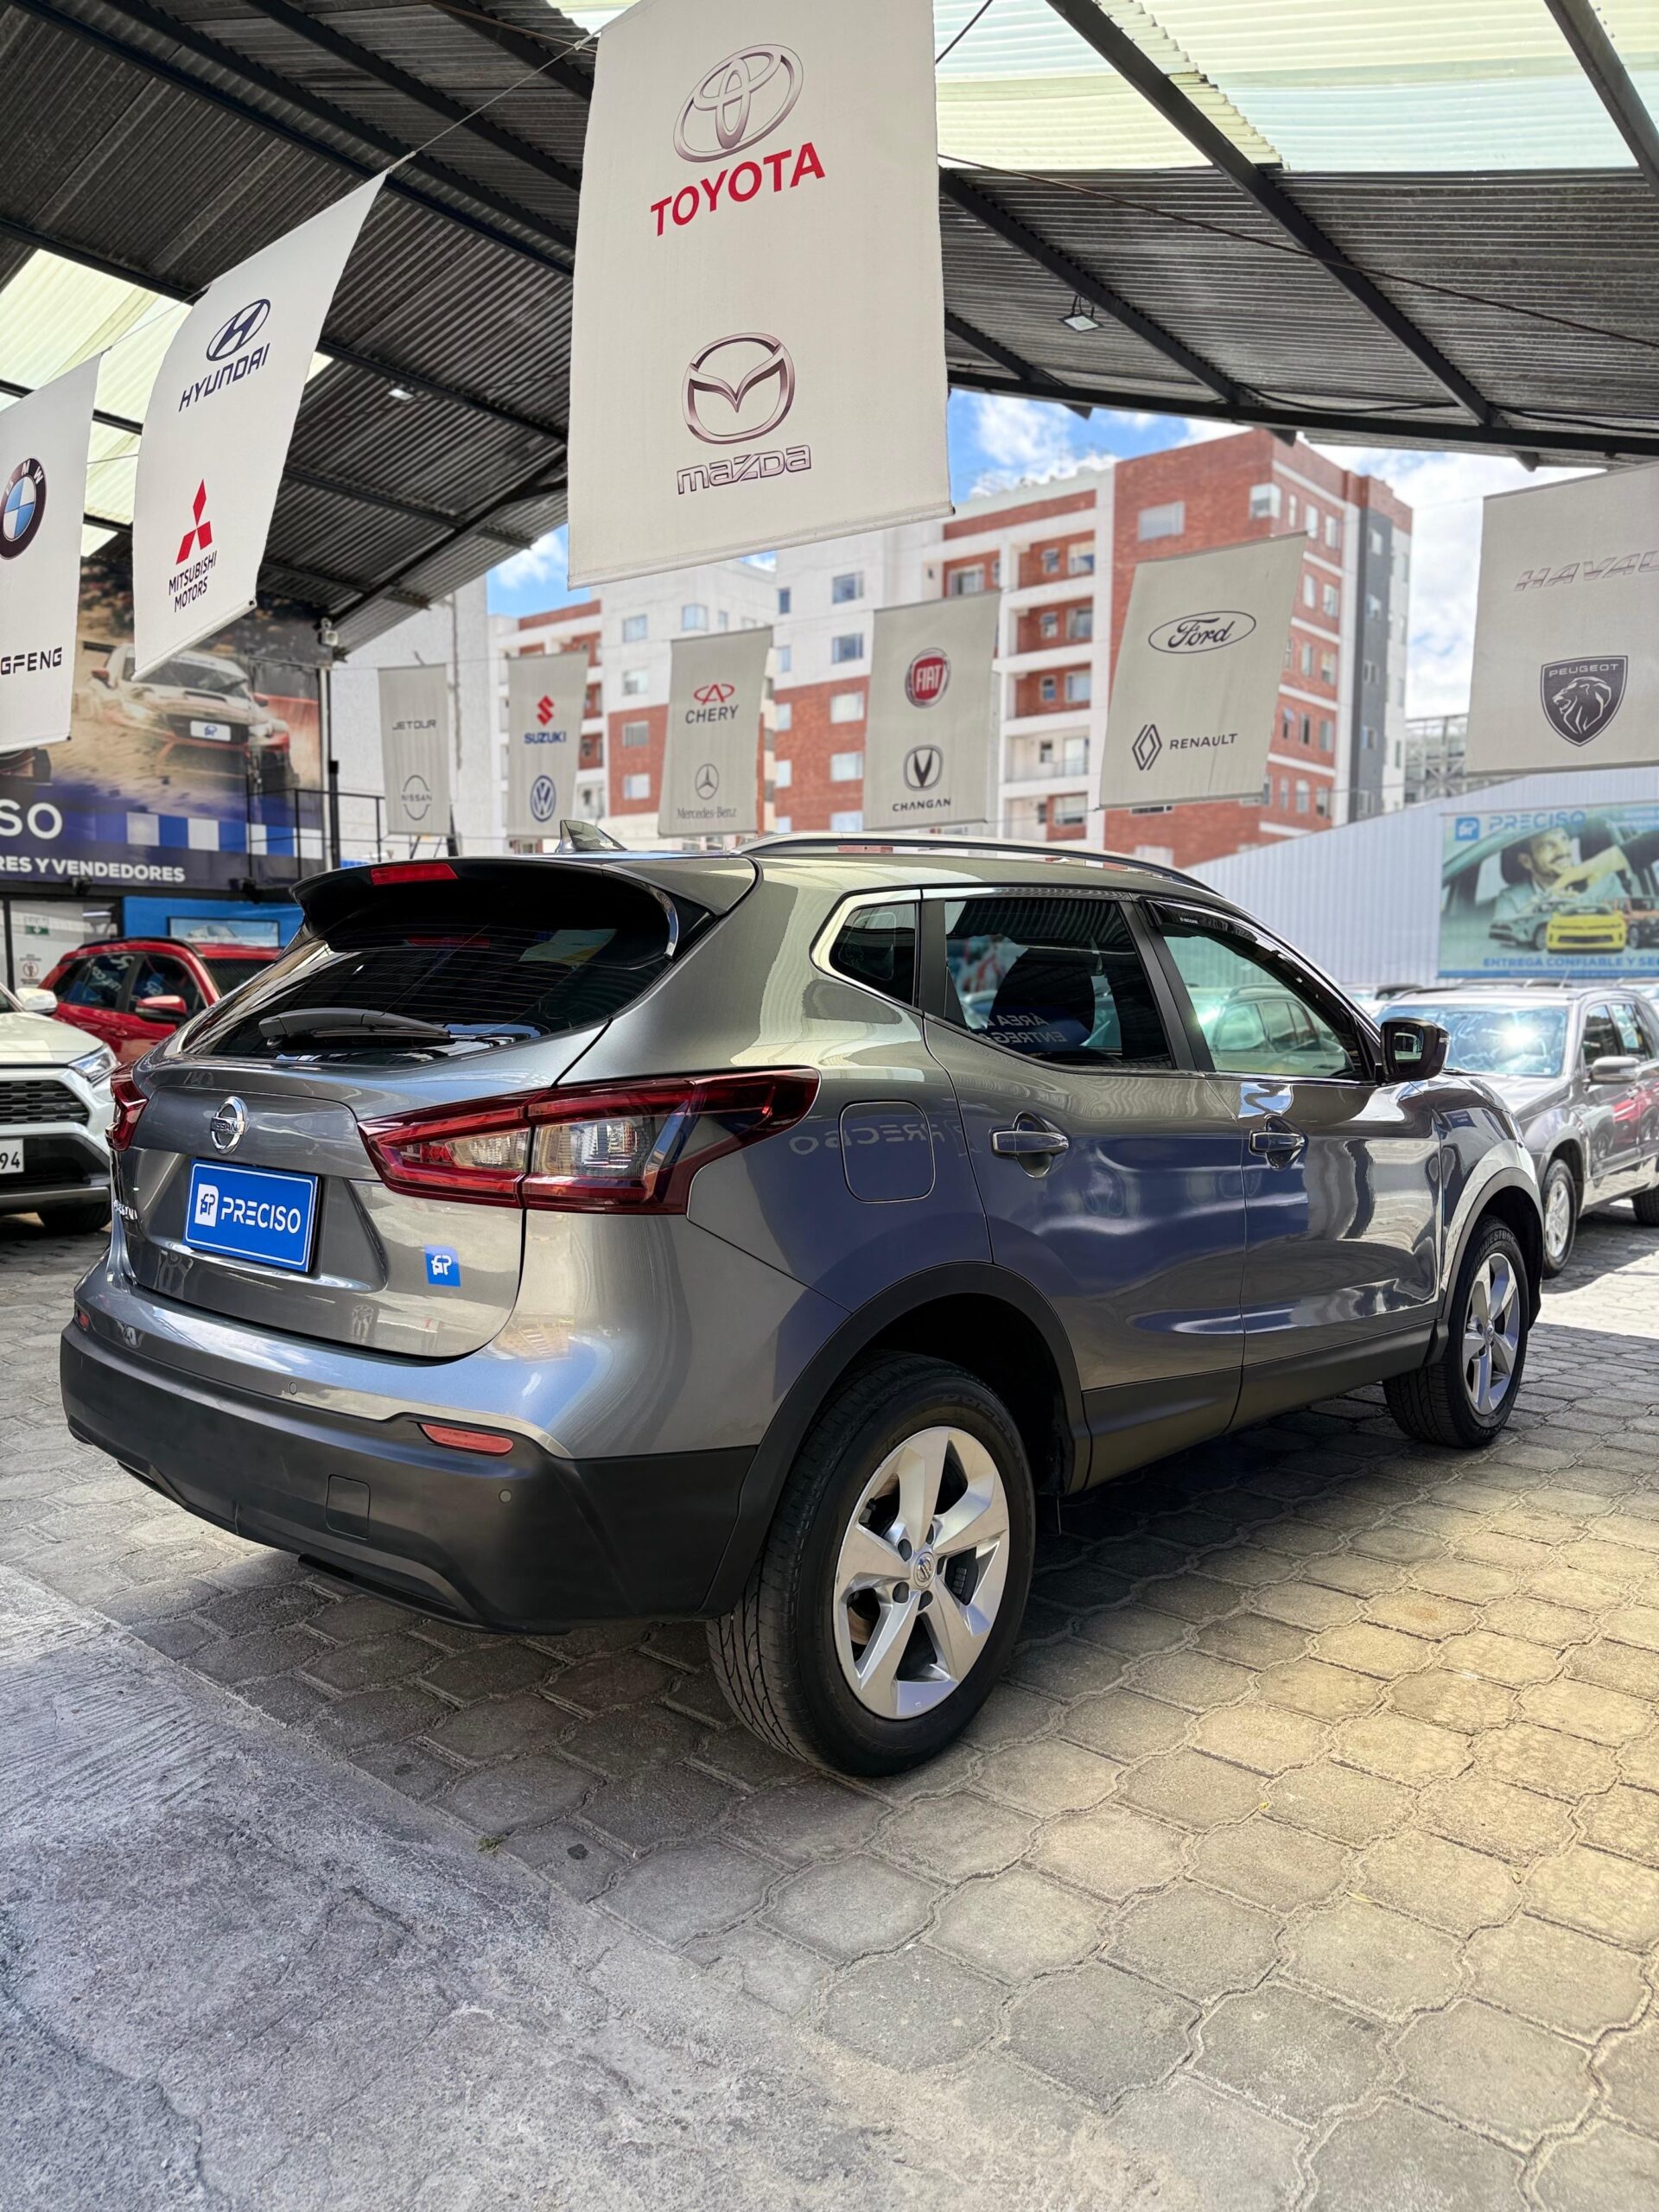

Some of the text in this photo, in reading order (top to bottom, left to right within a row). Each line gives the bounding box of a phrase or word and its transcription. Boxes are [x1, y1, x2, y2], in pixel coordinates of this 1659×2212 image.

[650, 142, 826, 237] TOYOTA
[178, 343, 270, 412] HYUNDAI
[168, 550, 218, 596] MITSUBISHI
[174, 575, 208, 613] MOTORS
[1167, 617, 1233, 648] Ford
[1, 646, 62, 676] GFENG
[1548, 663, 1619, 678] PEUGEOT
[915, 664, 943, 691] FIAT
[392, 719, 436, 731] JETOUR
[685, 704, 739, 725] CHERY
[524, 731, 566, 745] SUZUKI
[1169, 733, 1238, 751] RENAULT
[401, 793, 432, 802] NISSAN
[892, 798, 951, 812] CHANGAN
[0, 798, 63, 840] SO
[677, 806, 737, 820] Mercedes-Benz
[1488, 810, 1586, 830] PRECISO
[35, 857, 50, 873] Y
[52, 859, 186, 882] VENDEDORES
[1483, 957, 1545, 968] ENTREGA
[1546, 956, 1623, 968] CONFIABLE
[1625, 957, 1637, 967] Y
[220, 1197, 302, 1234] PRECISO
